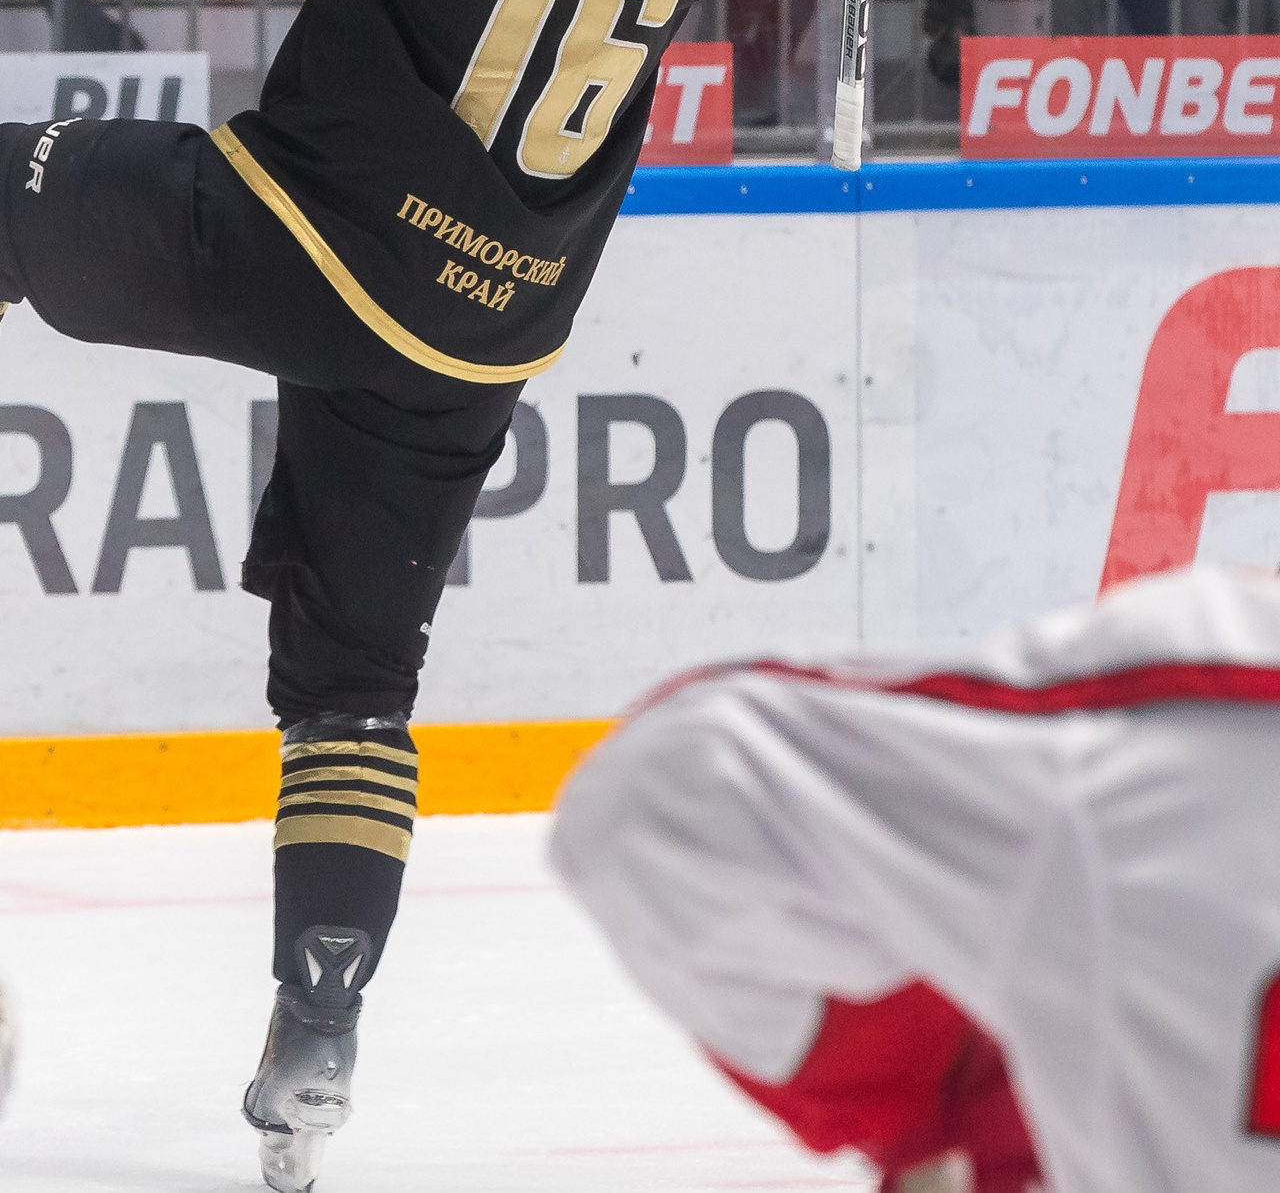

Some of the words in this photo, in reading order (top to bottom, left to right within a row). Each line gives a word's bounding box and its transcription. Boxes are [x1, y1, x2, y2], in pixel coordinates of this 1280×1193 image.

[643, 65, 726, 144] T
[968, 57, 1280, 137] FONBE
[25, 117, 82, 193] UER
[396, 193, 567, 286] ПРИМОРСКИЙ
[436, 259, 515, 311] КРАЙ
